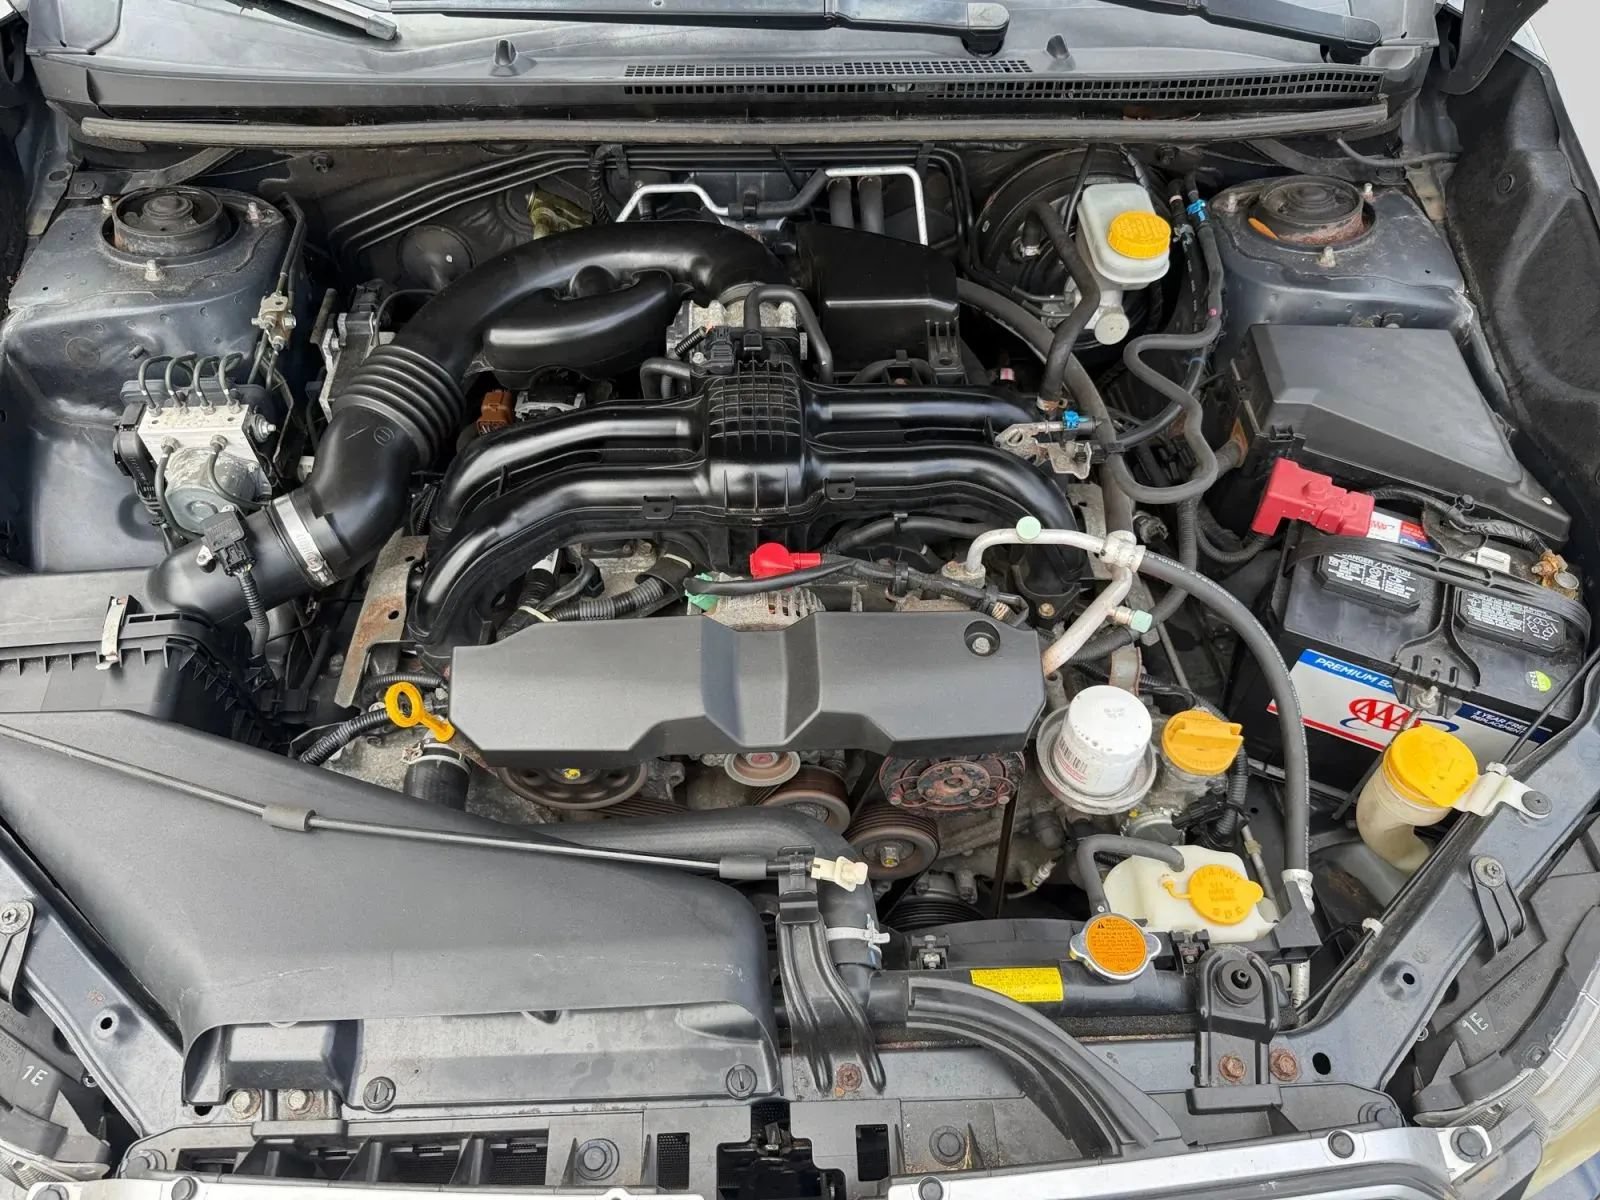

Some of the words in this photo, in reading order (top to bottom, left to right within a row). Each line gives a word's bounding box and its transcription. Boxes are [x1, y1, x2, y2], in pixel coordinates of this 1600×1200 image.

[1381, 563, 1412, 578] POISON
[1315, 657, 1379, 683] PREMIUM
[1482, 712, 1507, 725] YEAR
[1462, 1012, 1489, 1035] 1E
[21, 1065, 49, 1086] 1E
